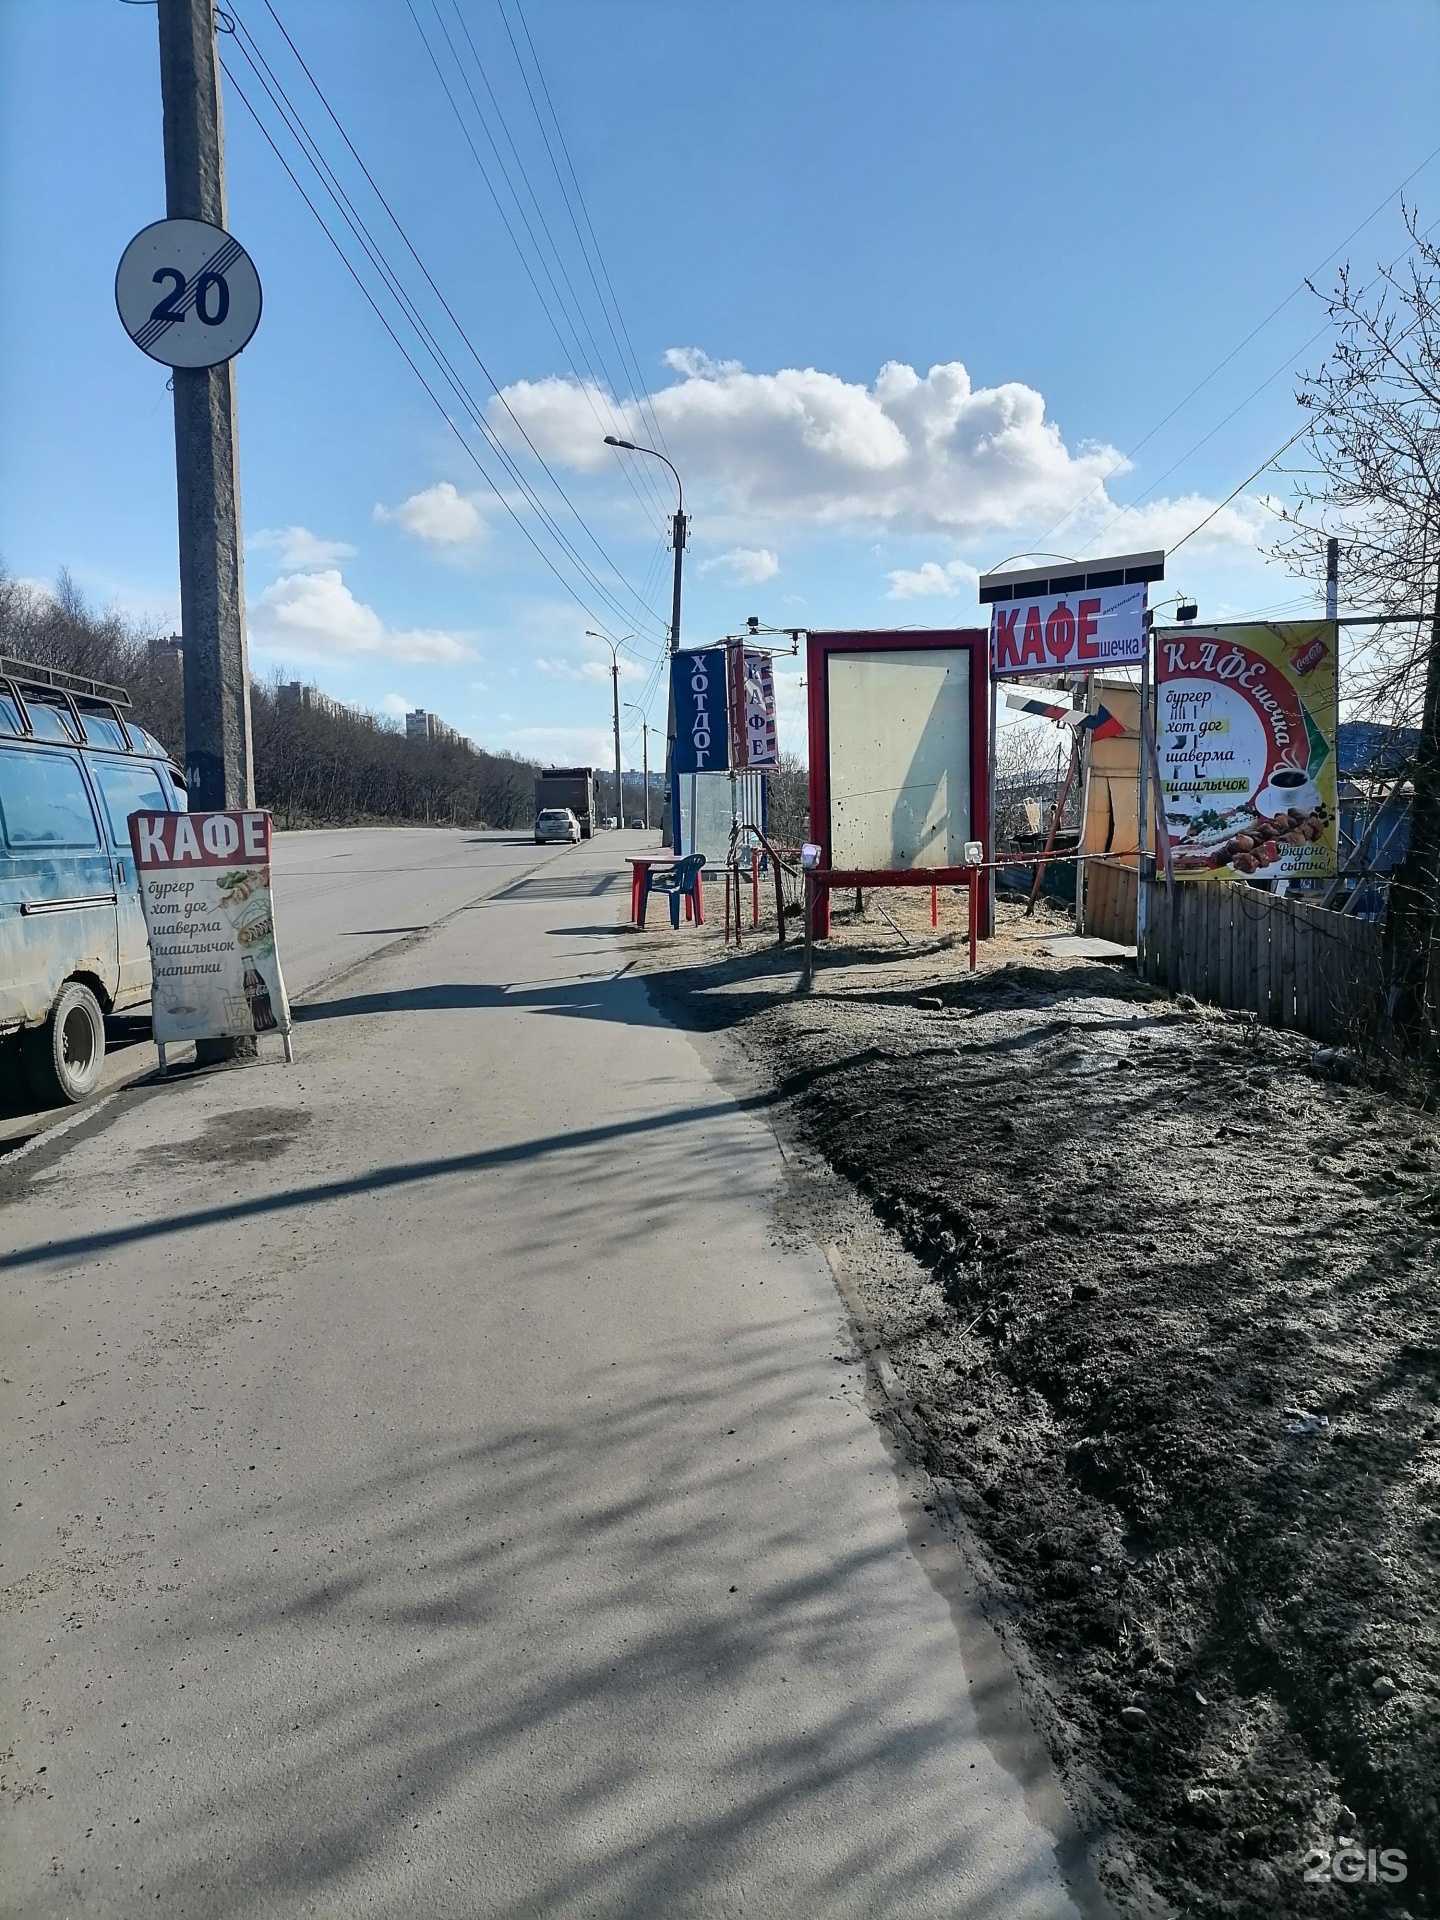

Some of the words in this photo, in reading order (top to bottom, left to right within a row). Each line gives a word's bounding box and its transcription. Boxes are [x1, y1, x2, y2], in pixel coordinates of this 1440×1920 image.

[150, 267, 230, 326] 20
[997, 598, 1101, 668] КАФЕ
[1101, 638, 1139, 657] шечка
[1166, 690, 1212, 709] бургер
[691, 655, 711, 768] ХОТДОГ
[747, 663, 766, 756] КАФЕ
[1166, 721, 1195, 734] хот
[1199, 720, 1224, 738] дог
[1166, 749, 1235, 767] шаверма
[1165, 780, 1248, 793] шашлычок
[137, 813, 267, 863] КАФЕ
[148, 881, 195, 899] бургер
[150, 903, 181, 915] хот
[184, 902, 208, 918] дог
[153, 921, 222, 939] шаверма
[155, 941, 235, 956] шашлычок
[154, 963, 223, 977] напитки
